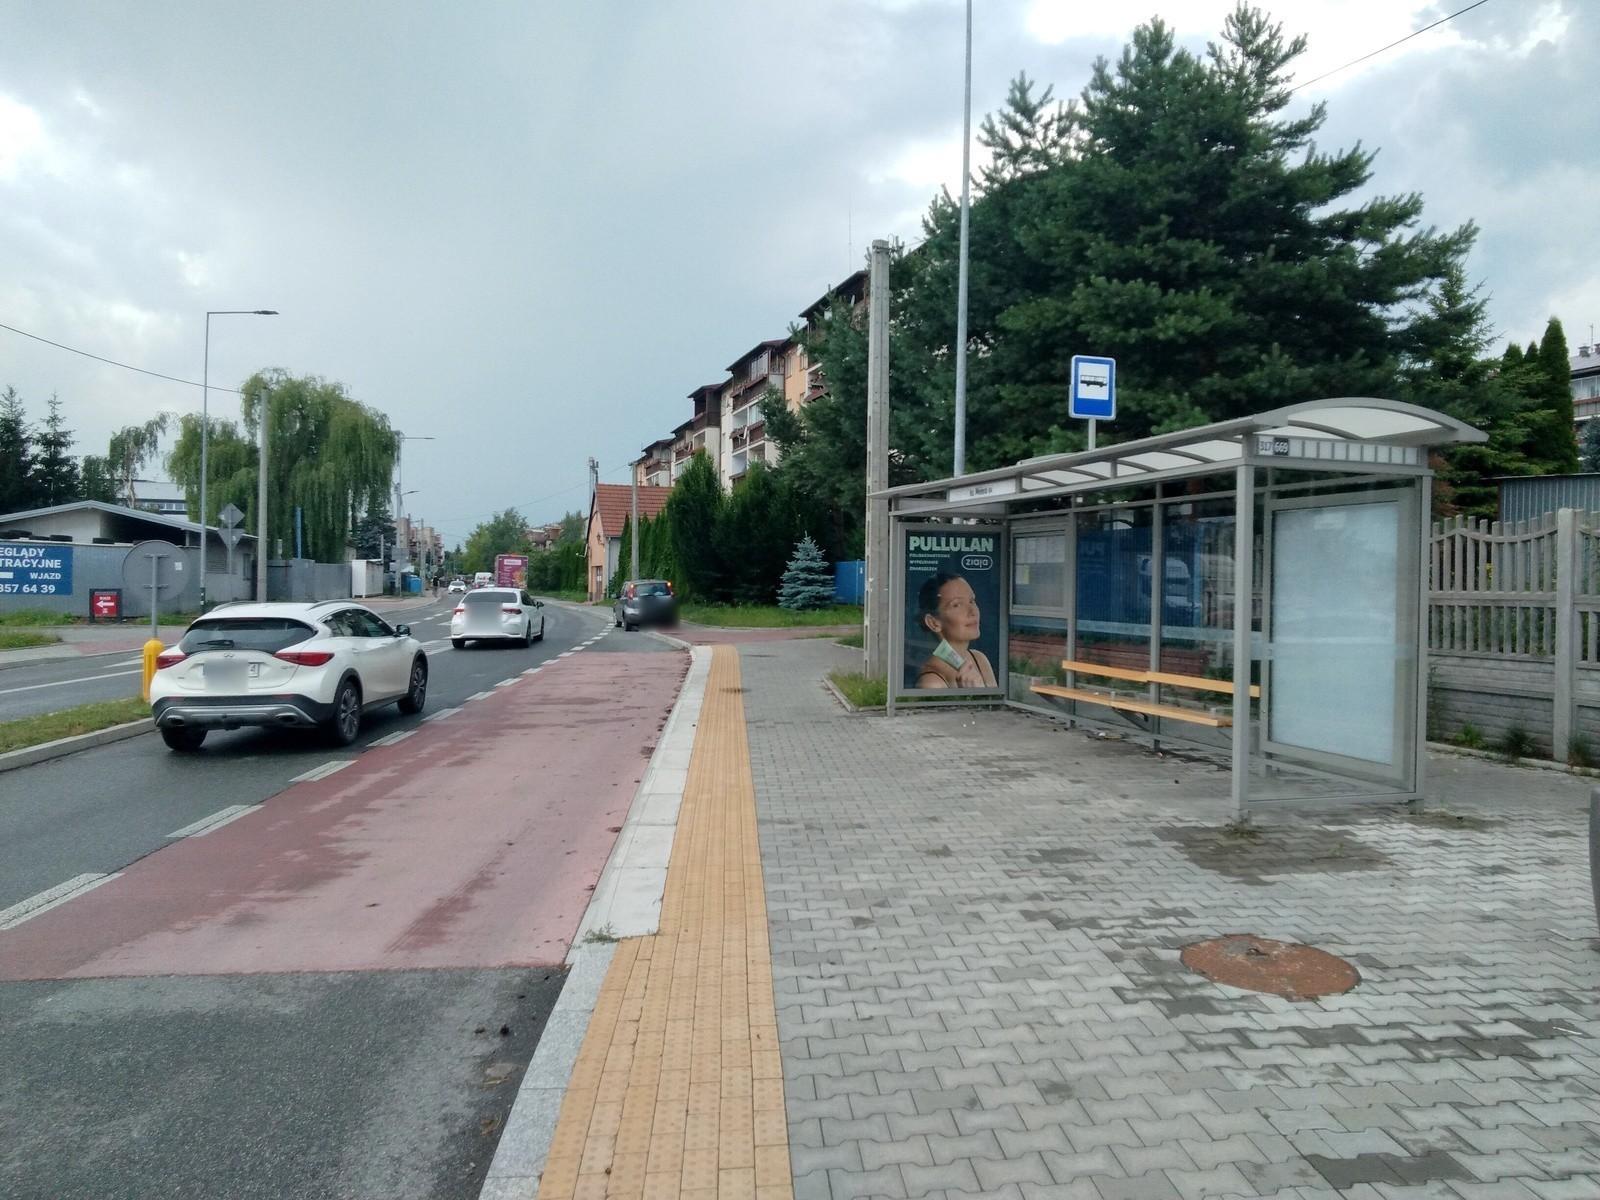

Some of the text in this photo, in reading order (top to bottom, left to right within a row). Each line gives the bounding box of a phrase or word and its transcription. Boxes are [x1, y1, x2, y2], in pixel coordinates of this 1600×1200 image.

[909, 536, 993, 552] PULLULAN
[22, 584, 37, 593] 64
[41, 585, 55, 593] 39
